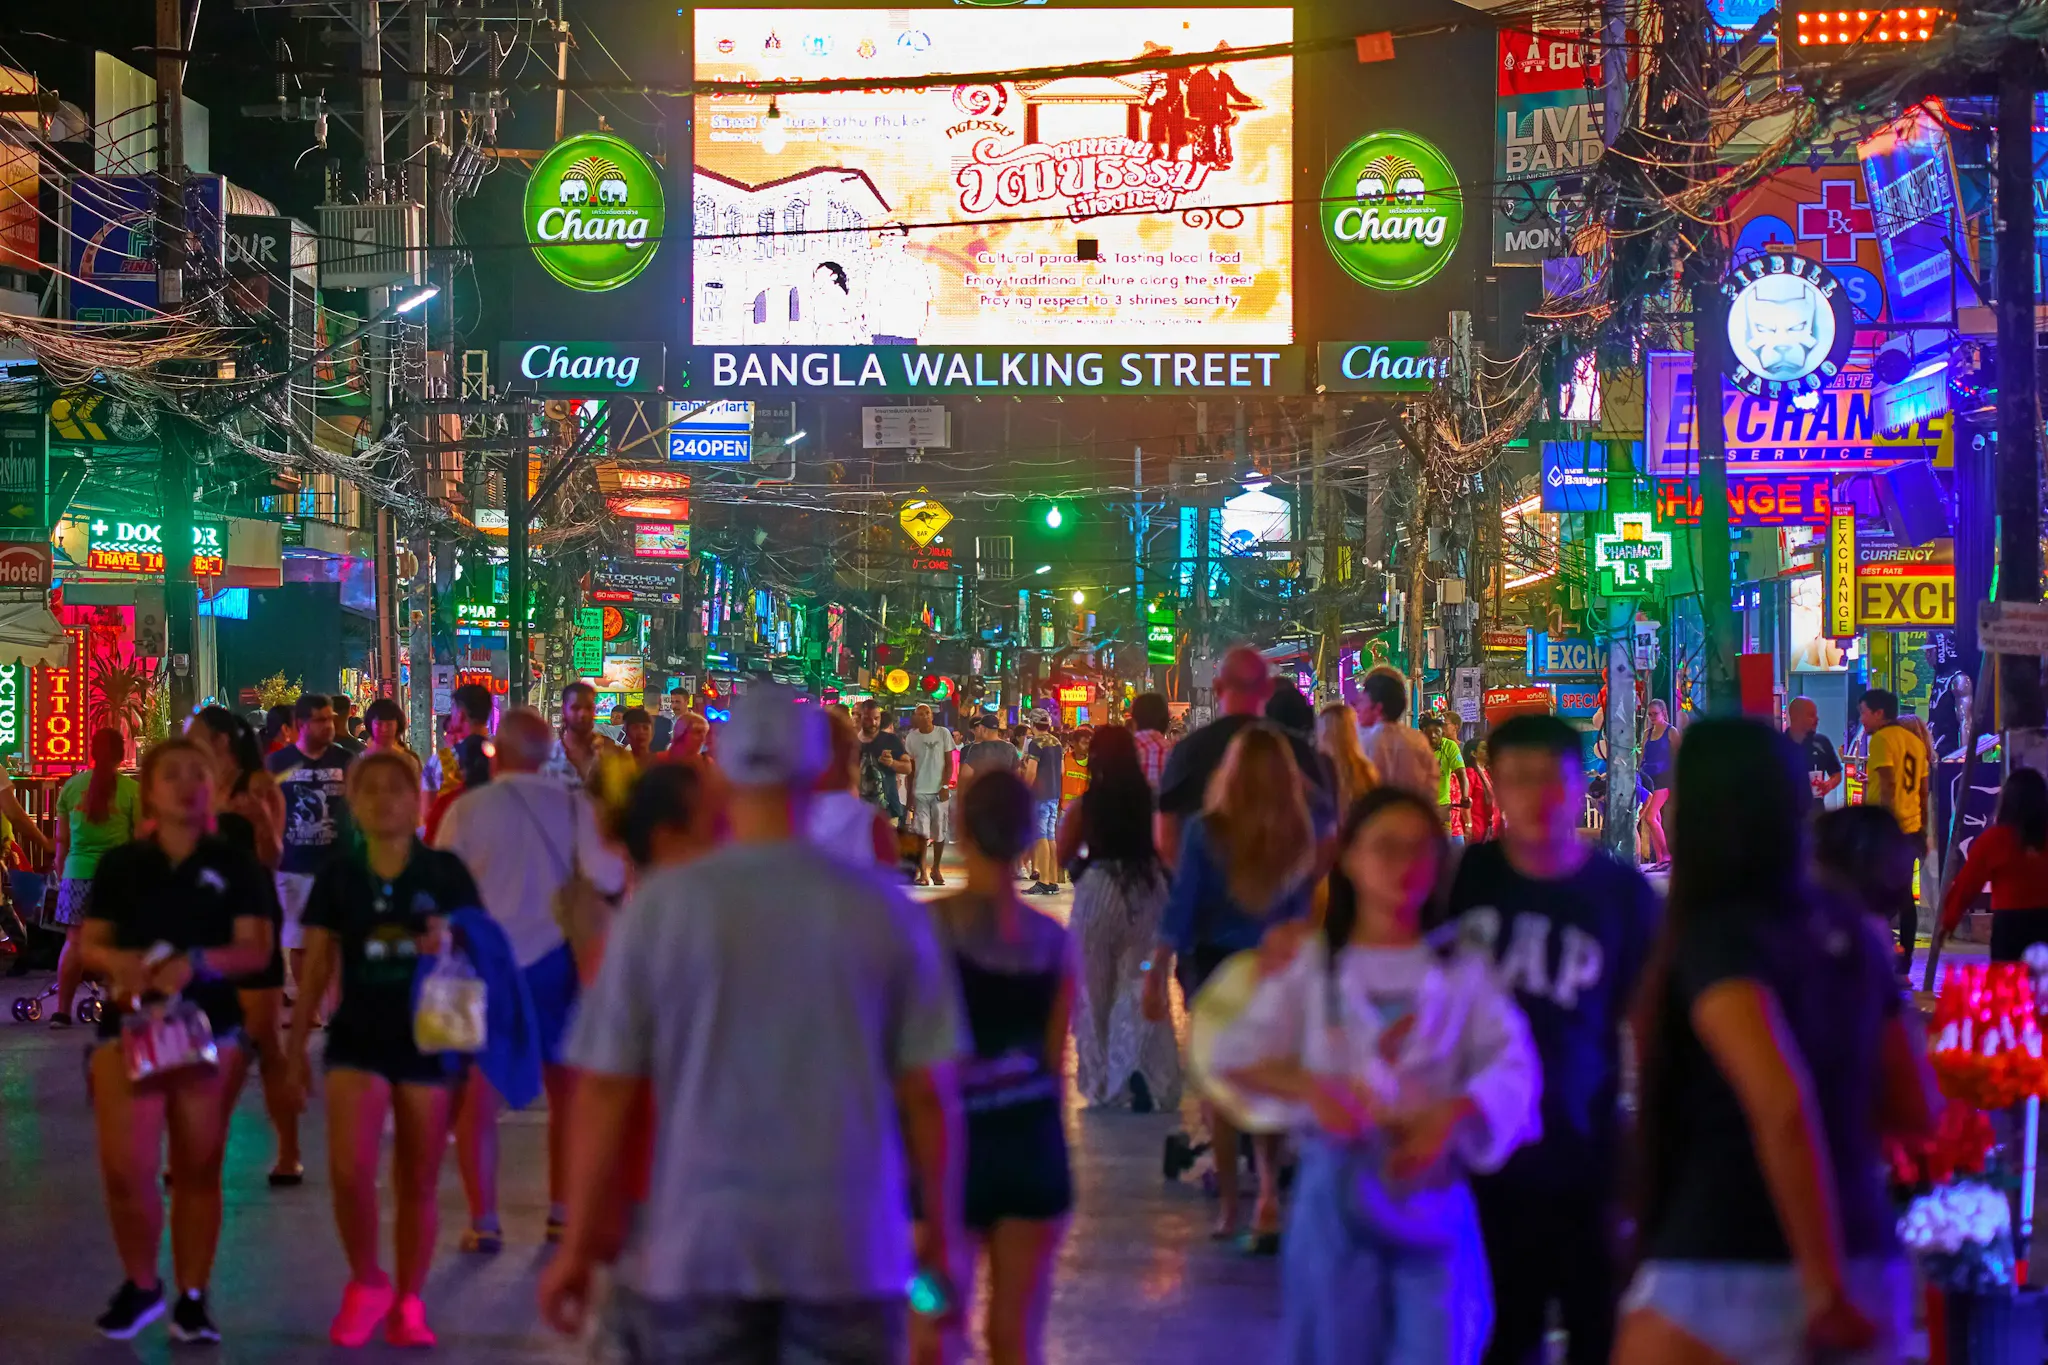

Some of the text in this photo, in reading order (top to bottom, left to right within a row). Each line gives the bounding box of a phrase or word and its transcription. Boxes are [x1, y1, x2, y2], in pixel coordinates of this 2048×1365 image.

[1507, 102, 1604, 146] LIVE
[1506, 139, 1606, 174] BAND
[537, 207, 650, 248] Chang
[1334, 207, 1448, 247] Chang
[1115, 252, 1164, 267] Tasting
[1209, 252, 1241, 264] food
[1087, 275, 1135, 286] culture
[1185, 275, 1207, 286] the
[1213, 275, 1254, 286] street
[1720, 255, 1838, 300] PITBULL
[1038, 294, 1089, 308] respect
[1095, 294, 1109, 306] to
[1115, 294, 1122, 306] 3
[1129, 294, 1177, 306] shrines
[1184, 294, 1238, 308] sanctity
[521, 345, 640, 387] Chang
[712, 352, 1281, 388] BANGLA WALKING STREET
[1732, 360, 1838, 399] TATTOO
[672, 439, 748, 457] 24OPEN
[1728, 449, 1874, 461] SERVICE
[98, 553, 140, 567] TRAVEL
[1603, 544, 1663, 559] PHARMACY
[1861, 549, 1934, 561] CURRENCY
[0, 562, 43, 583] Hotel
[600, 573, 676, 583] STOCKHOLM
[1839, 519, 1848, 632] EXCHANGE
[1861, 567, 1904, 575] BEST RATE
[1148, 633, 1173, 643] Chang
[1487, 694, 1510, 705] ATM
[47, 668, 71, 755] TTOO
[1904, 751, 1917, 794] 9
